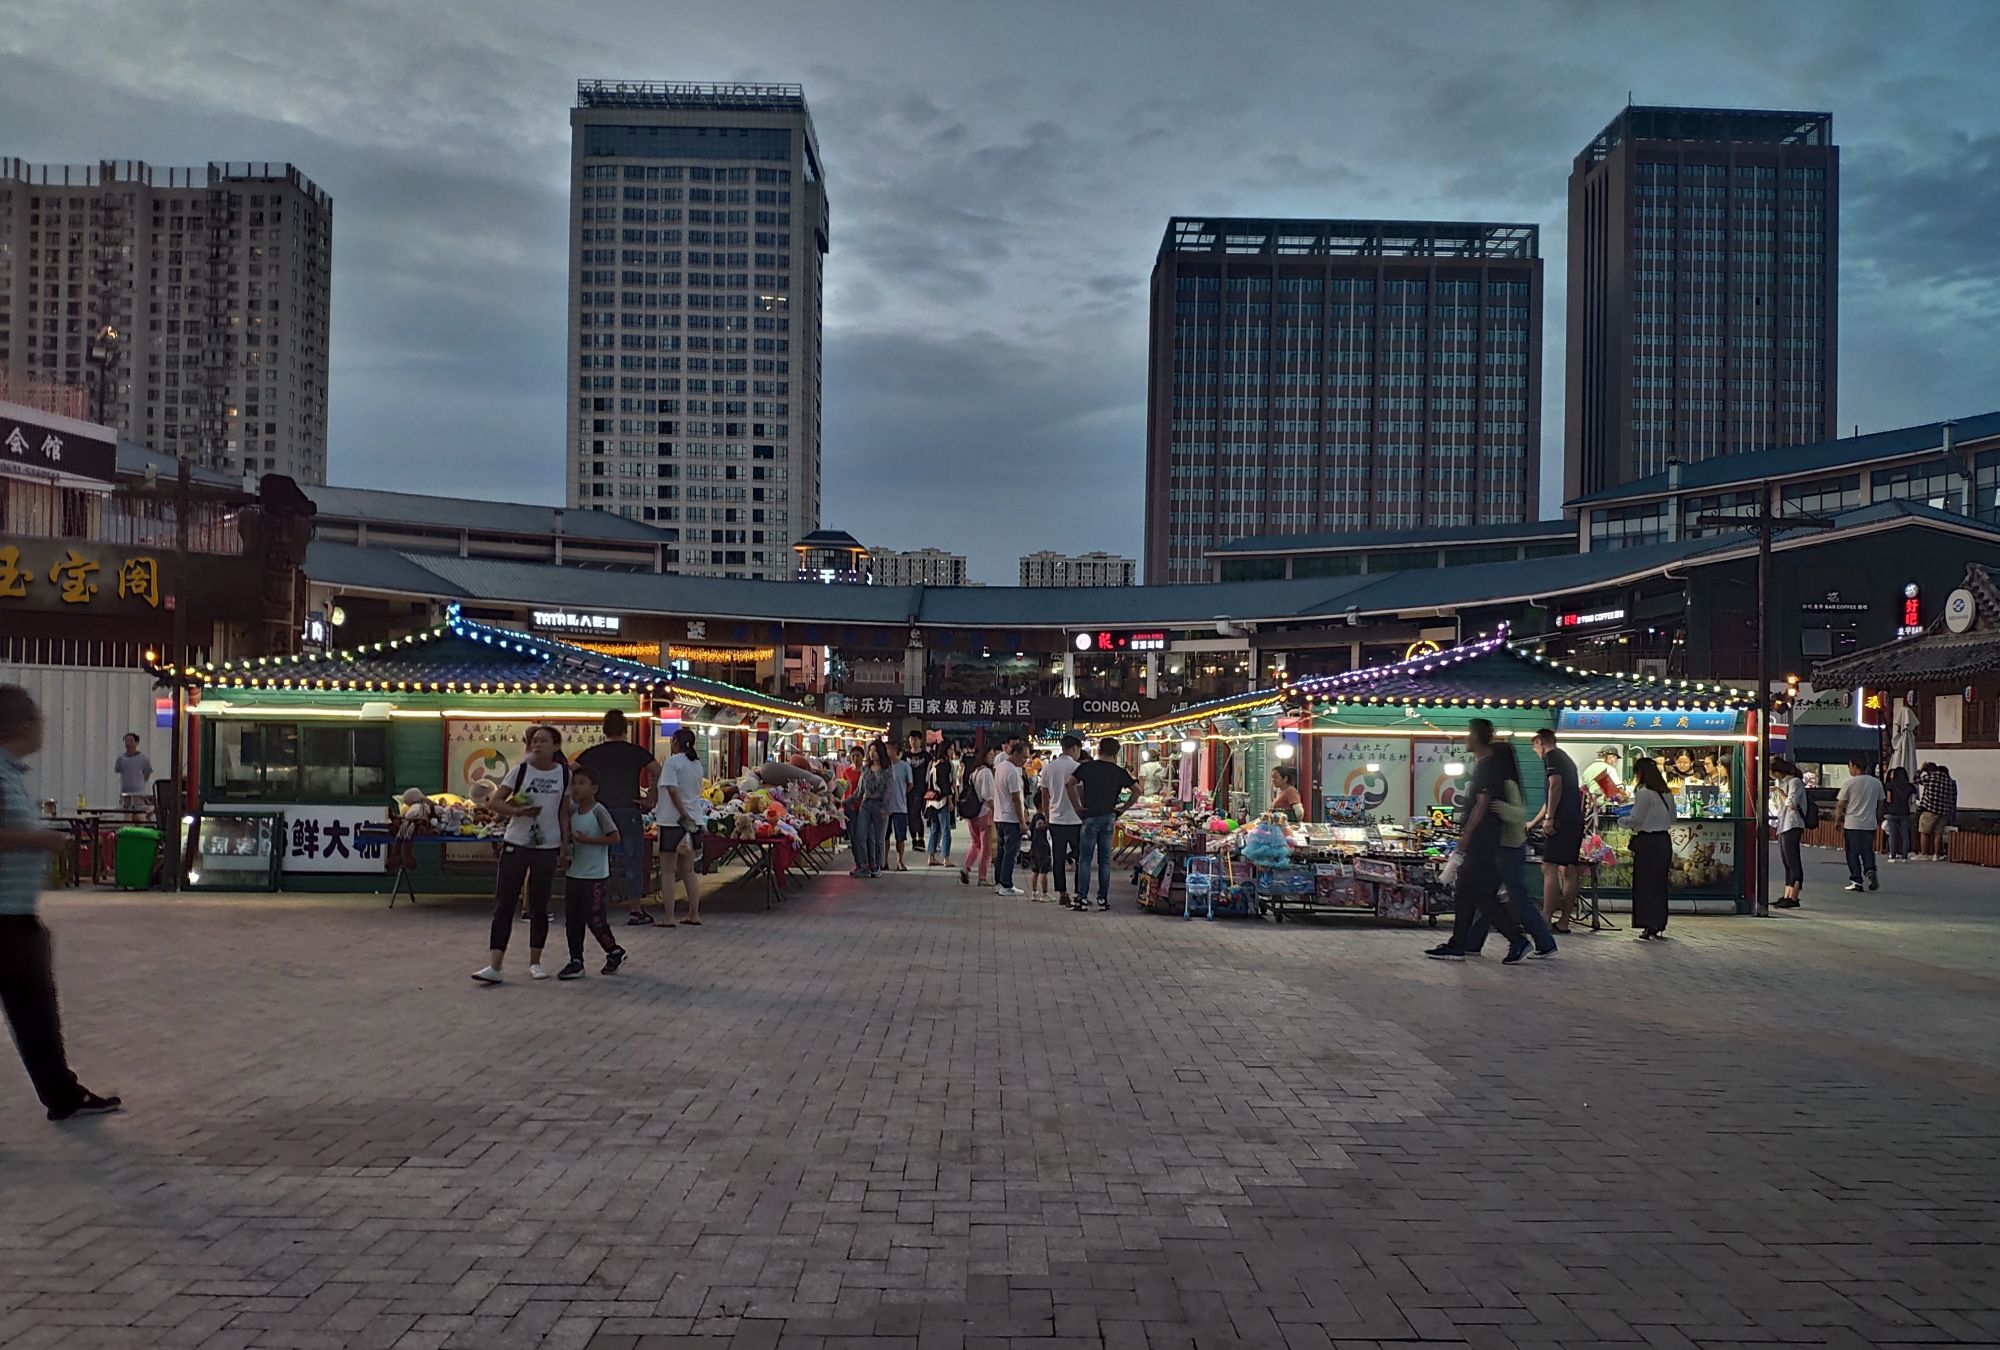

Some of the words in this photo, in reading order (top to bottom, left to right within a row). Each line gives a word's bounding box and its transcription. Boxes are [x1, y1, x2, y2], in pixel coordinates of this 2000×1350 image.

[5, 426, 63, 461] 会馆
[1082, 700, 1140, 713] CONBOA
[283, 818, 382, 860] 鲜大
